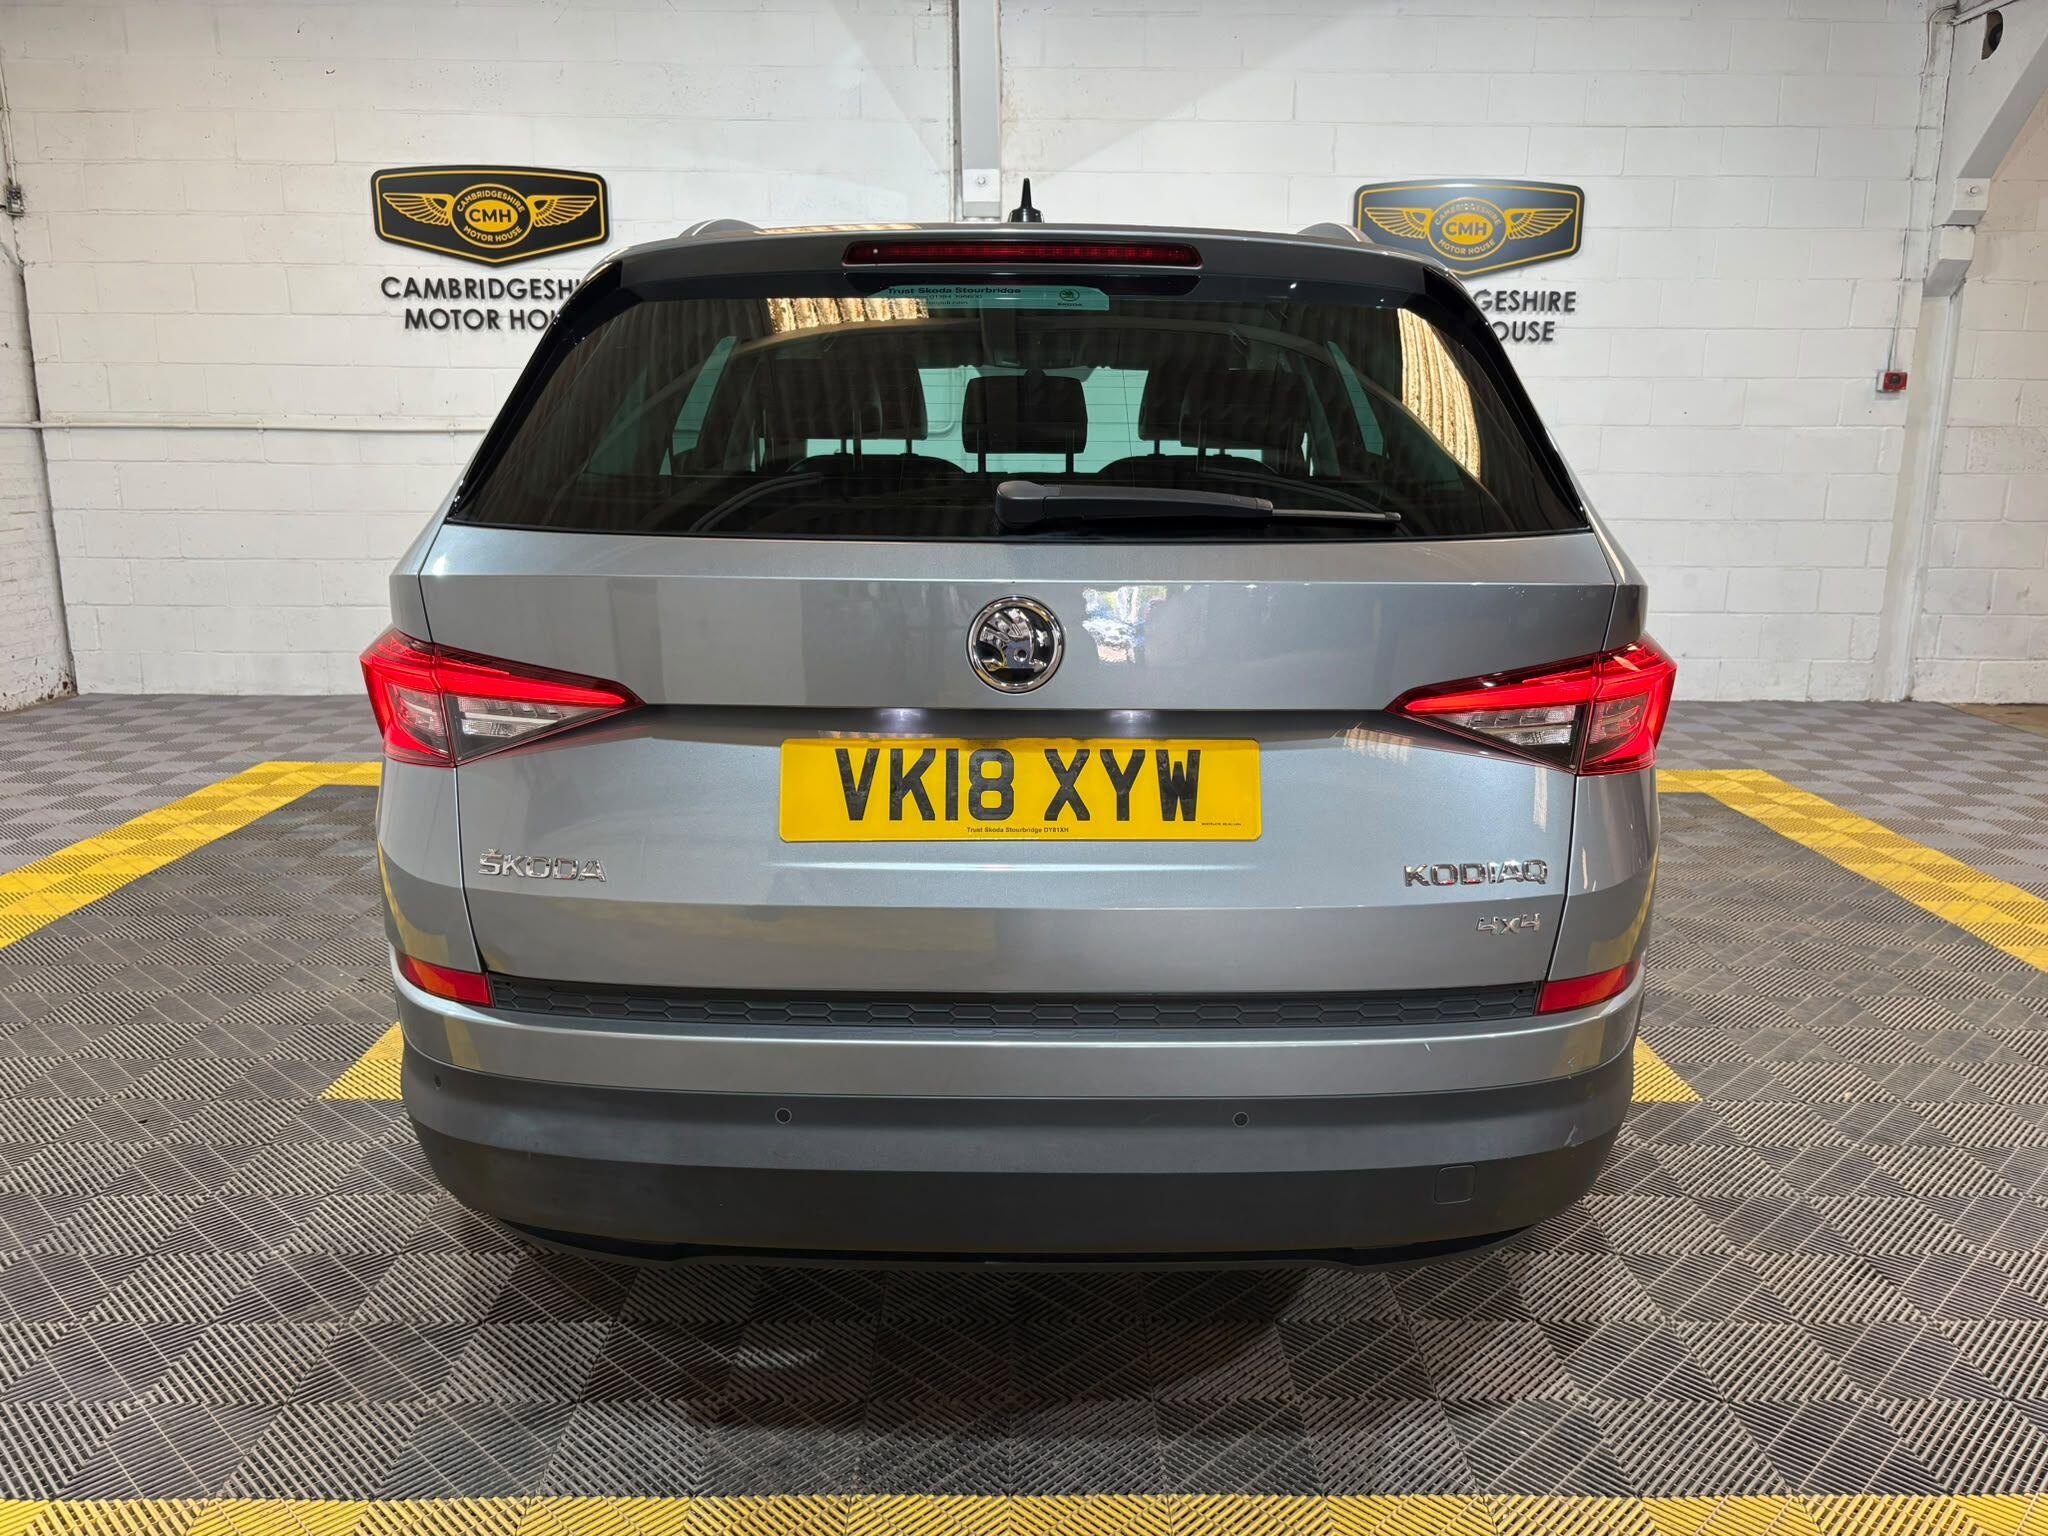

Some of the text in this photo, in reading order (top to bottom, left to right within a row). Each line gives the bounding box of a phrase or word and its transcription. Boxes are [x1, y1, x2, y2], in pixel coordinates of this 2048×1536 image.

[457, 190, 526, 214] CAMBRIDGESHIRE
[469, 208, 512, 223] CMH
[463, 225, 523, 242] MOTOR HOUSE
[1446, 221, 1488, 236] CMH
[1439, 239, 1496, 255] MOTOR HOUSE
[381, 276, 581, 300] CAMBRIDGESH
[955, 287, 1022, 295] Stourbridge
[1473, 289, 1577, 313] GESHIRE
[404, 308, 555, 332] MOTOR HO
[1492, 321, 1555, 342] OUSE
[834, 747, 1202, 822] VK18 XYW
[1404, 859, 1548, 887] KODIAQ
